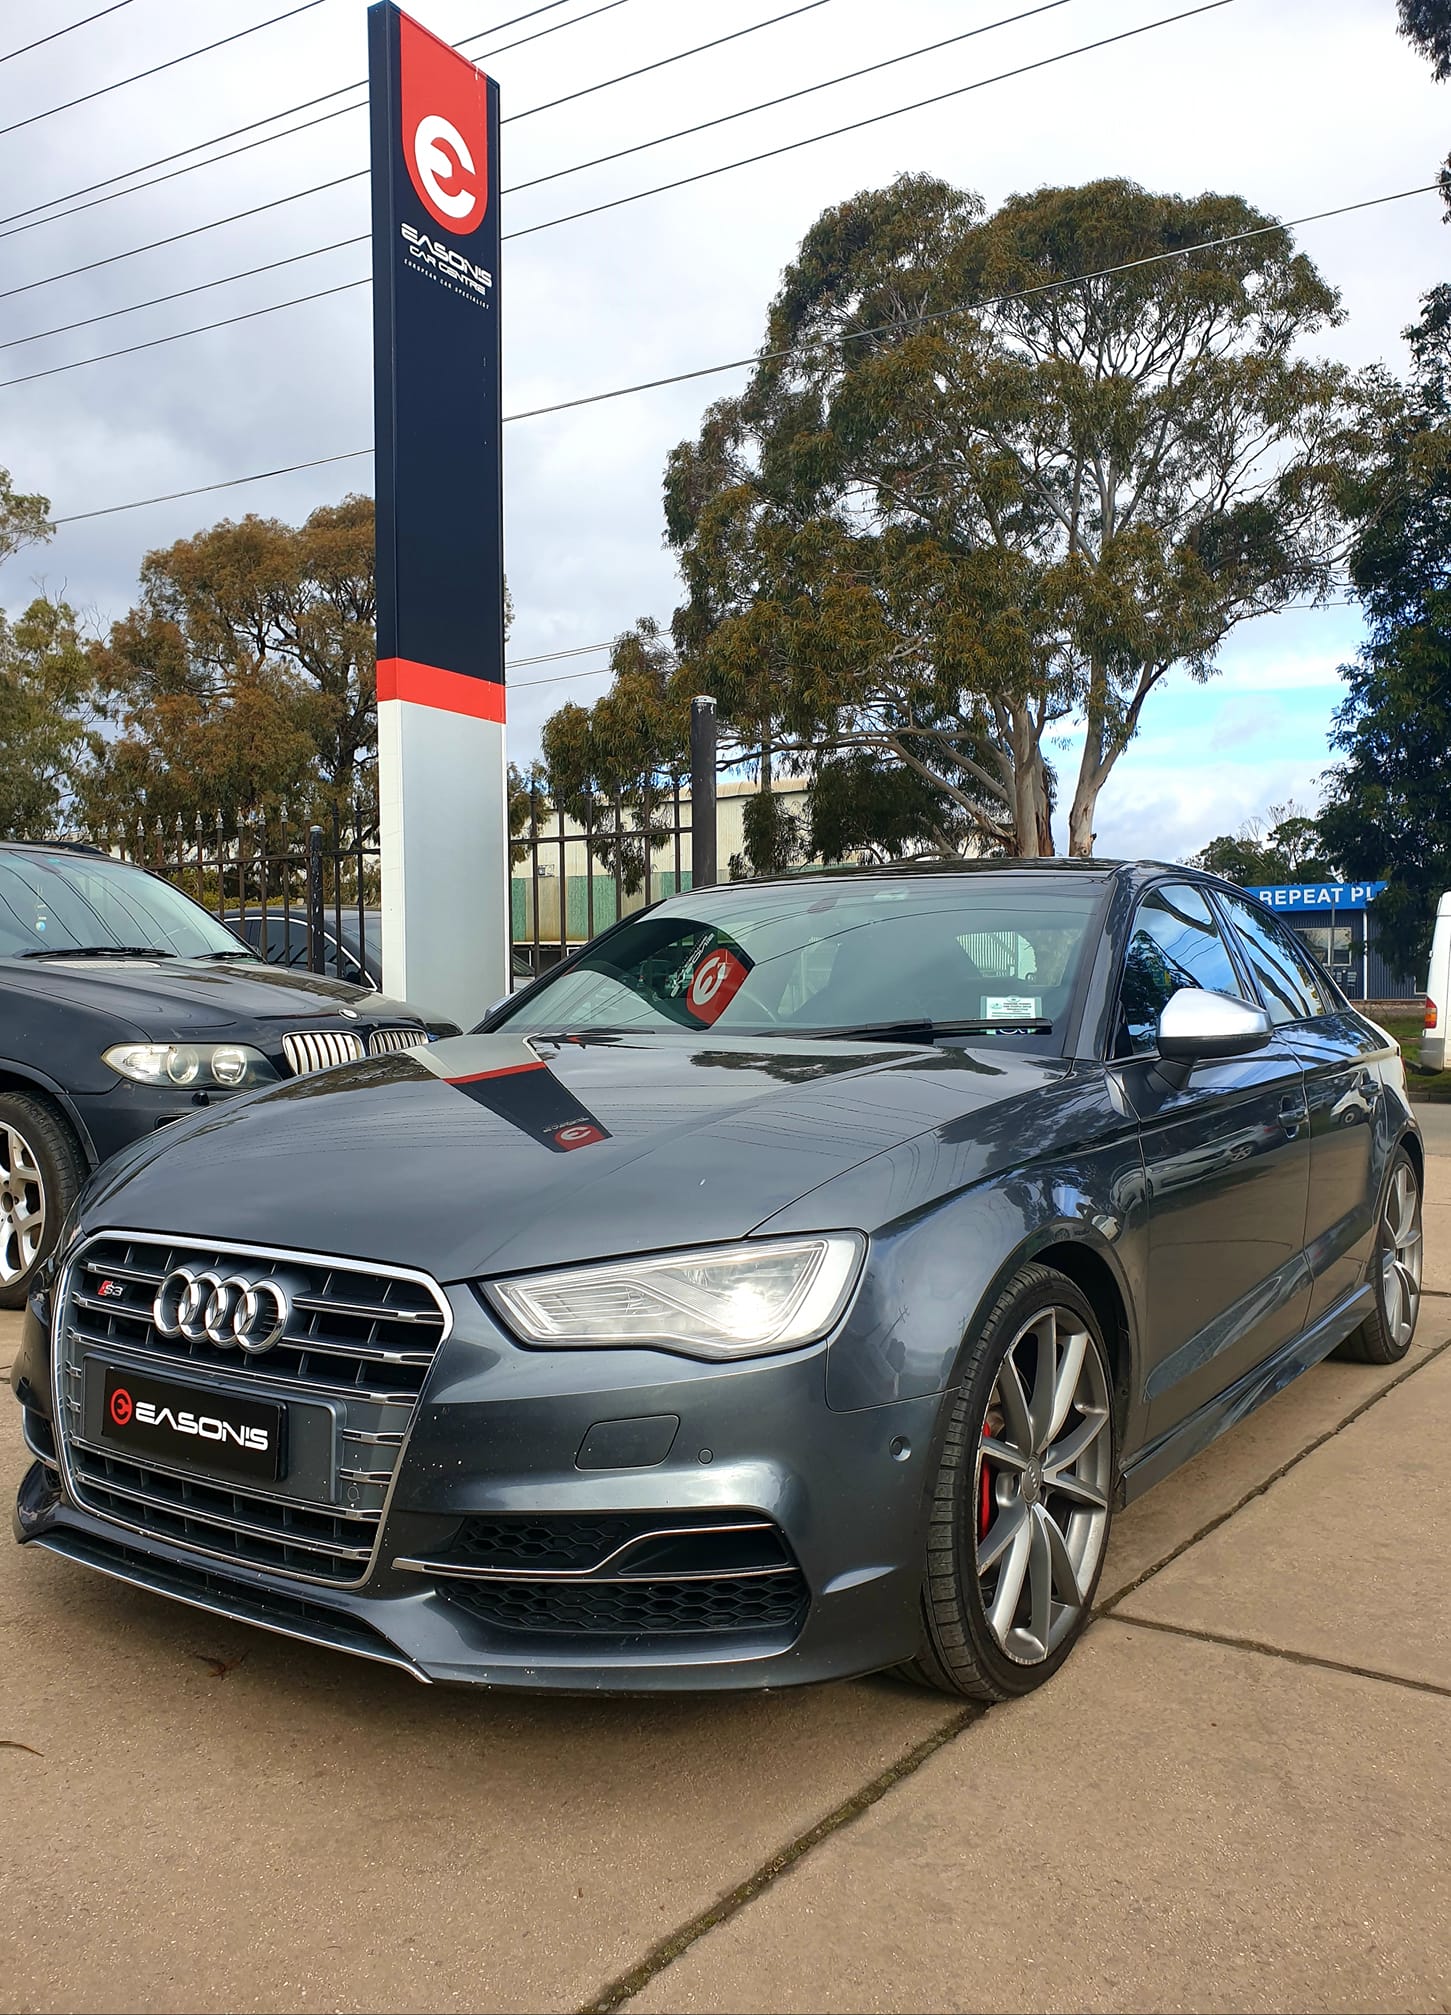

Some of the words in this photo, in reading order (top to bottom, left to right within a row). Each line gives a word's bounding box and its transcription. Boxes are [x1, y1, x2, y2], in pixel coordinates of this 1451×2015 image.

[404, 258, 437, 281] EUROPEAN
[440, 279, 452, 289] CAR
[455, 287, 490, 310] SPECIALIST
[409, 245, 437, 268] CAR
[438, 261, 486, 296] CENTRE
[1260, 888, 1344, 906] REPEAT
[101, 1281, 124, 1297] S3
